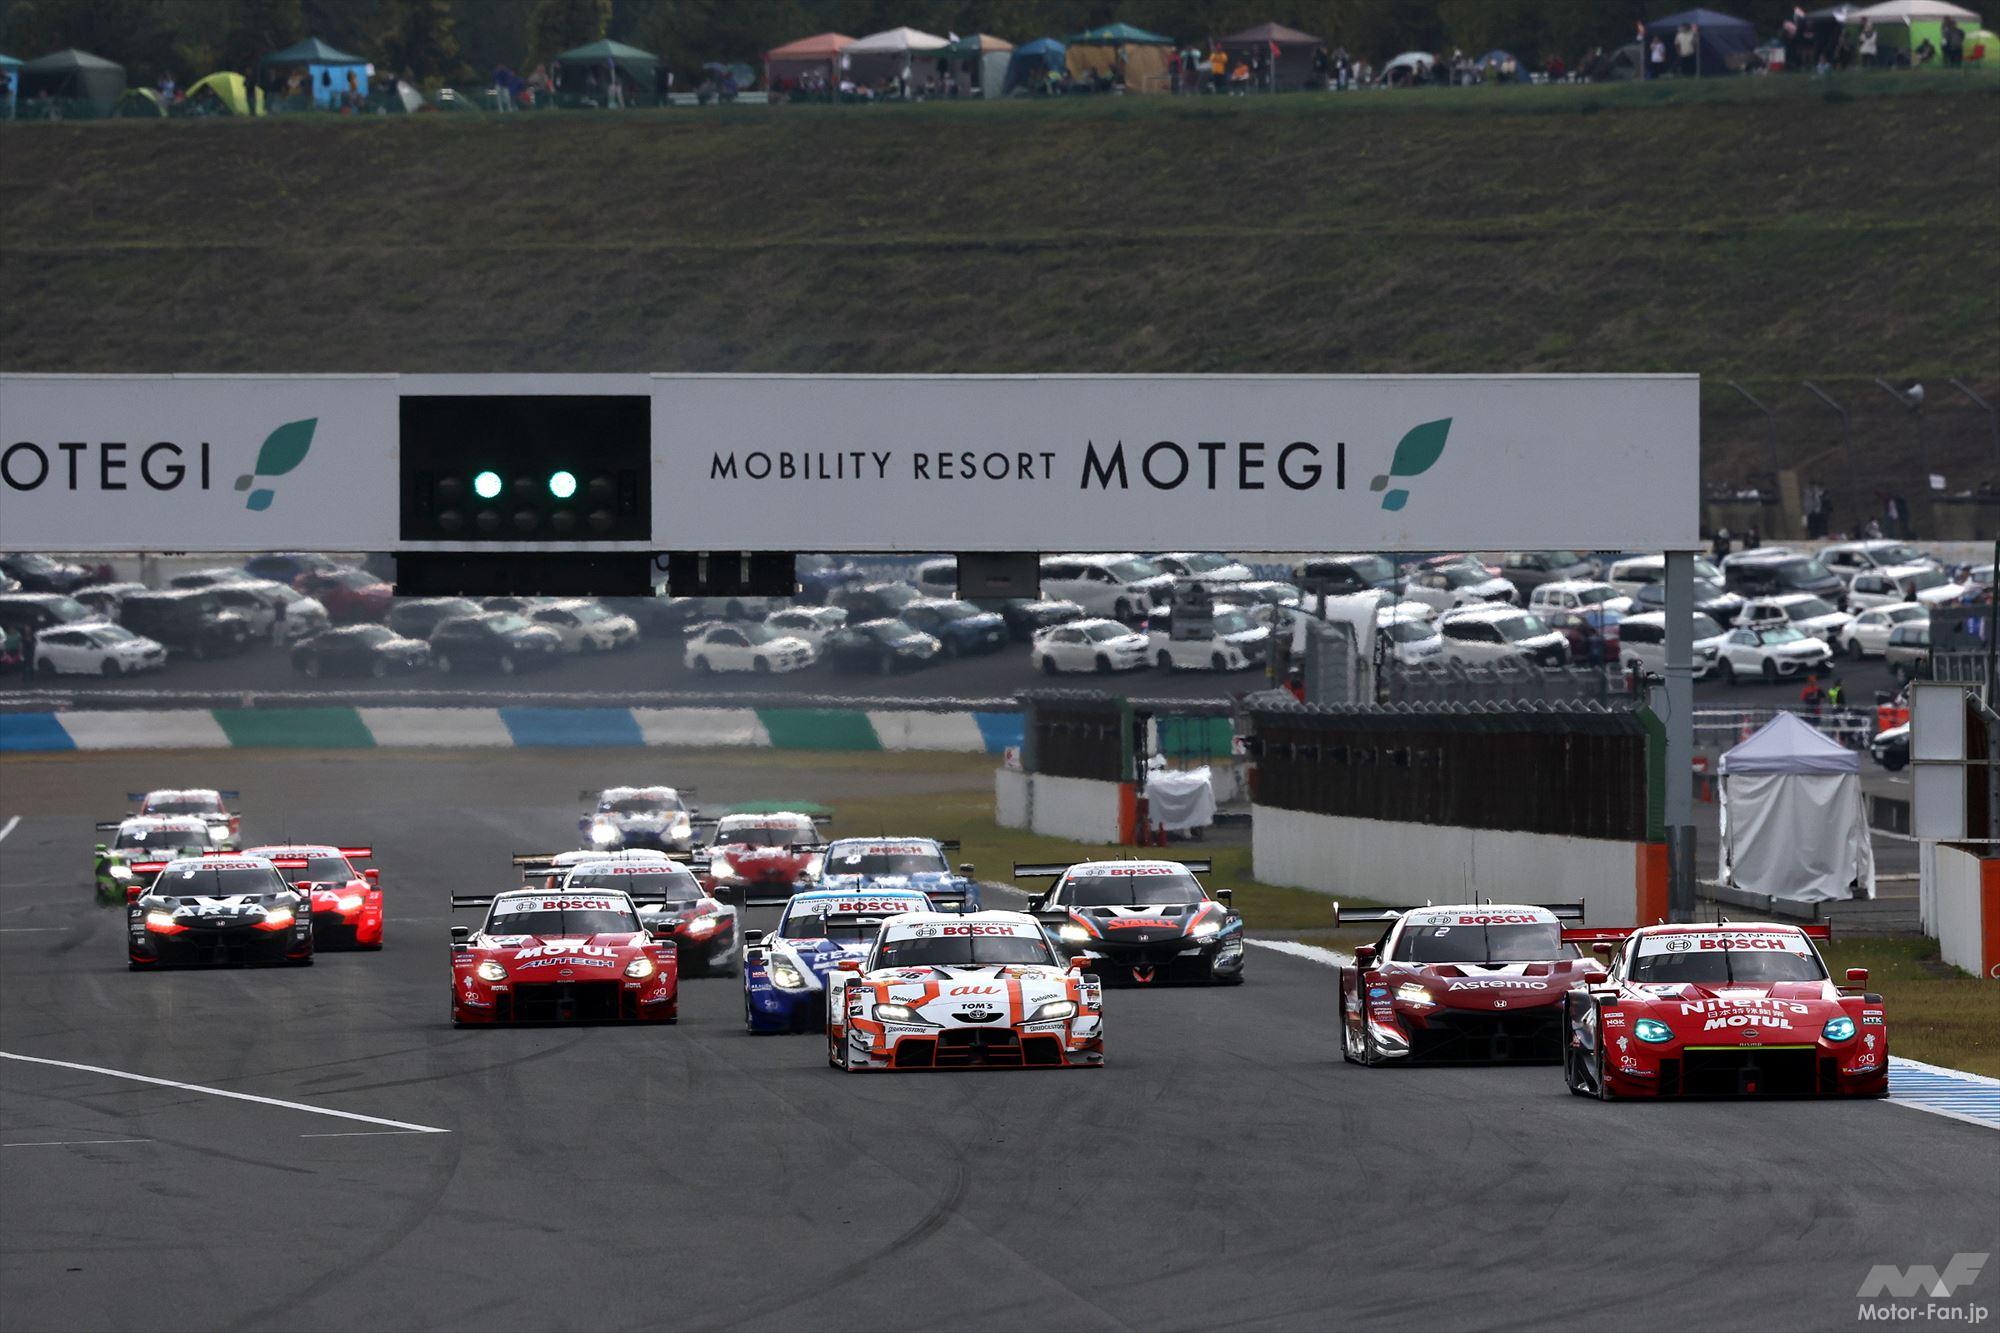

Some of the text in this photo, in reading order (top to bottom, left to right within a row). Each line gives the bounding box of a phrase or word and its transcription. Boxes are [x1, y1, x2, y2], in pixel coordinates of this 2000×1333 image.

[710, 440, 1345, 490] MOBILITY RESORT MOTEGI
[201, 862, 258, 870] BOSCH
[1110, 868, 1174, 876] BOSCH
[170, 903, 271, 917] ARTA
[542, 900, 611, 910] BOSCH
[838, 902, 909, 912] BOSCH
[1458, 914, 1538, 925] BOSCH
[943, 926, 1015, 936] BOSCH
[1699, 939, 1786, 950] BOSCH
[514, 946, 619, 960] MOTUL
[516, 957, 615, 970] AUTECH
[949, 985, 1002, 997] au
[1448, 979, 1549, 992] Astemo
[1680, 998, 1809, 1016] Niterra
[1703, 1014, 1794, 1031] MOTUL
